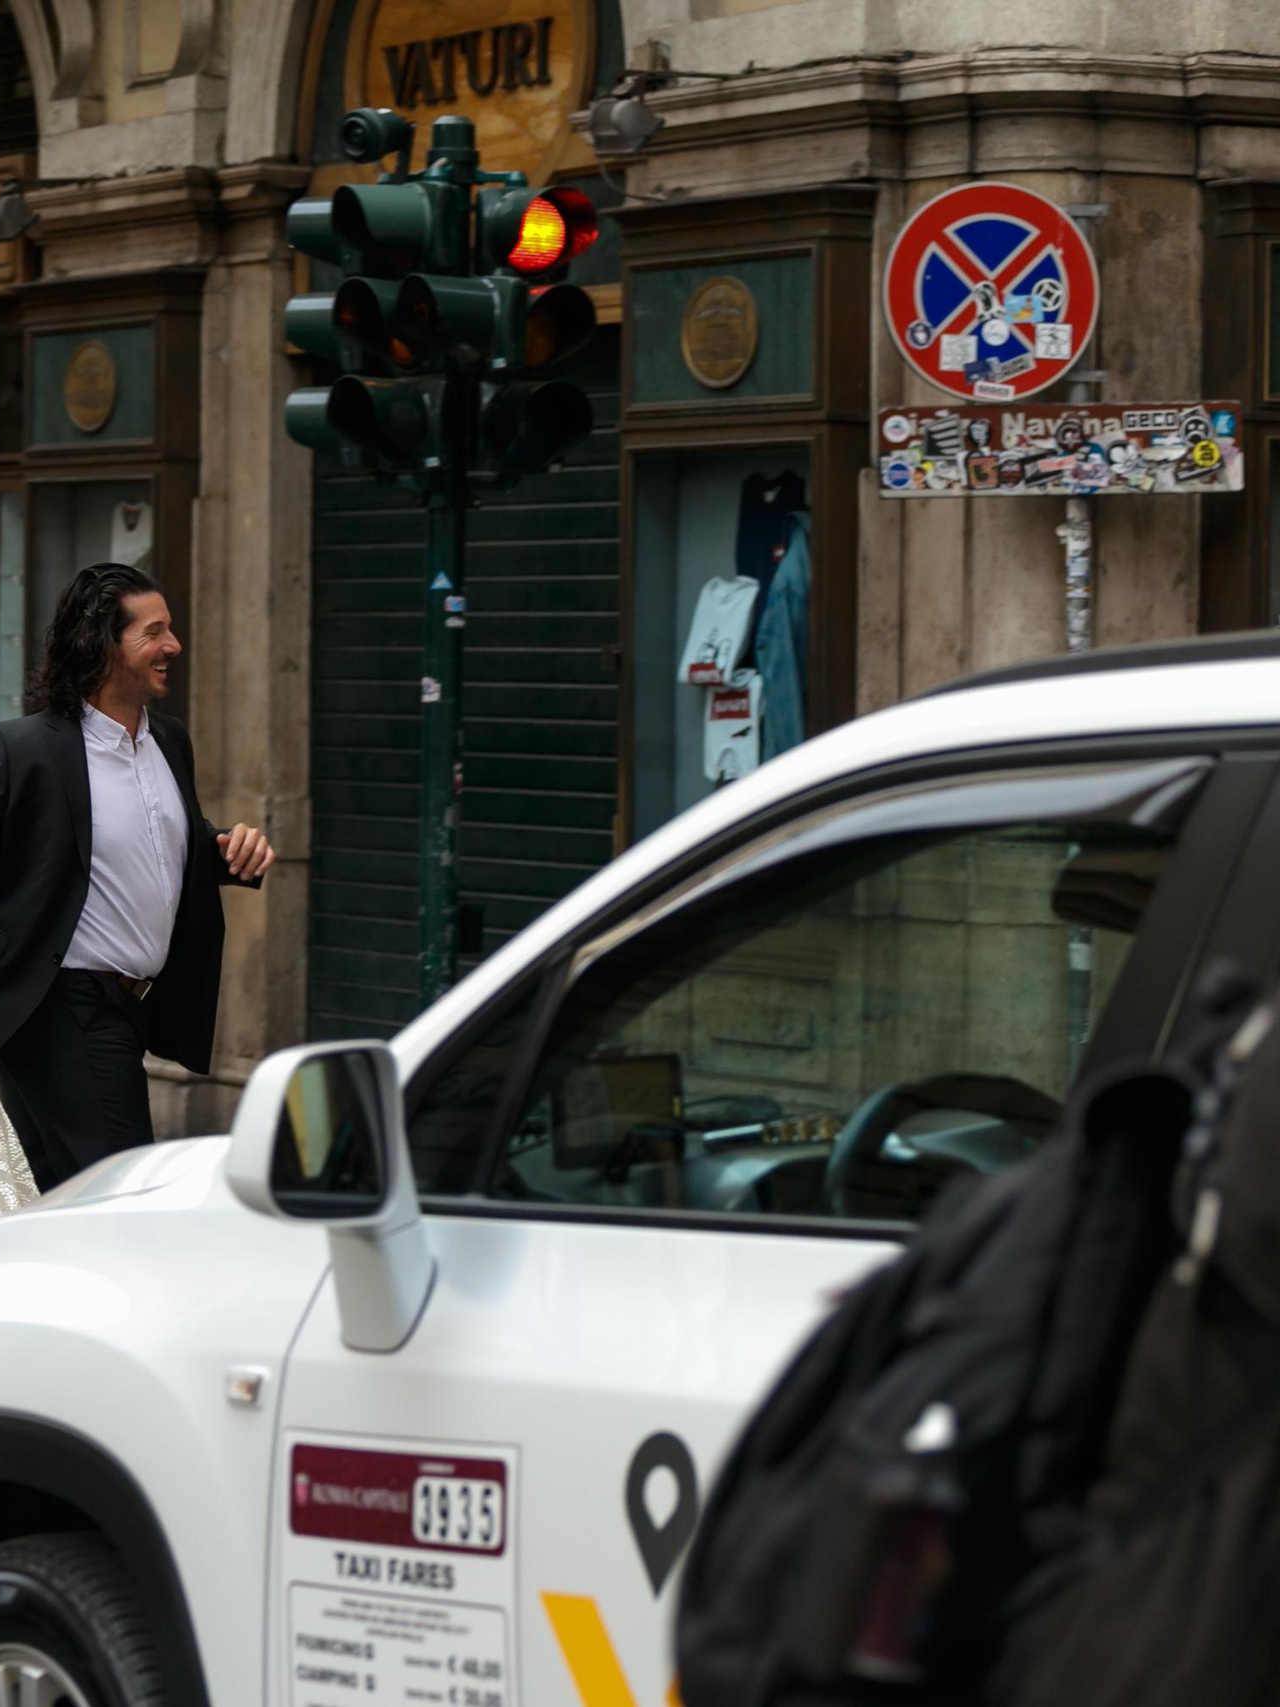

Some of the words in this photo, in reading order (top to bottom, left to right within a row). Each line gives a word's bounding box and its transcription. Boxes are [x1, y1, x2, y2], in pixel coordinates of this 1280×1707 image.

[382, 17, 553, 109] VATURI
[1001, 411, 1122, 437] Navna
[420, 1483, 495, 1543] 3935
[334, 1551, 382, 1583] TAXI
[387, 1558, 455, 1591] FARES
